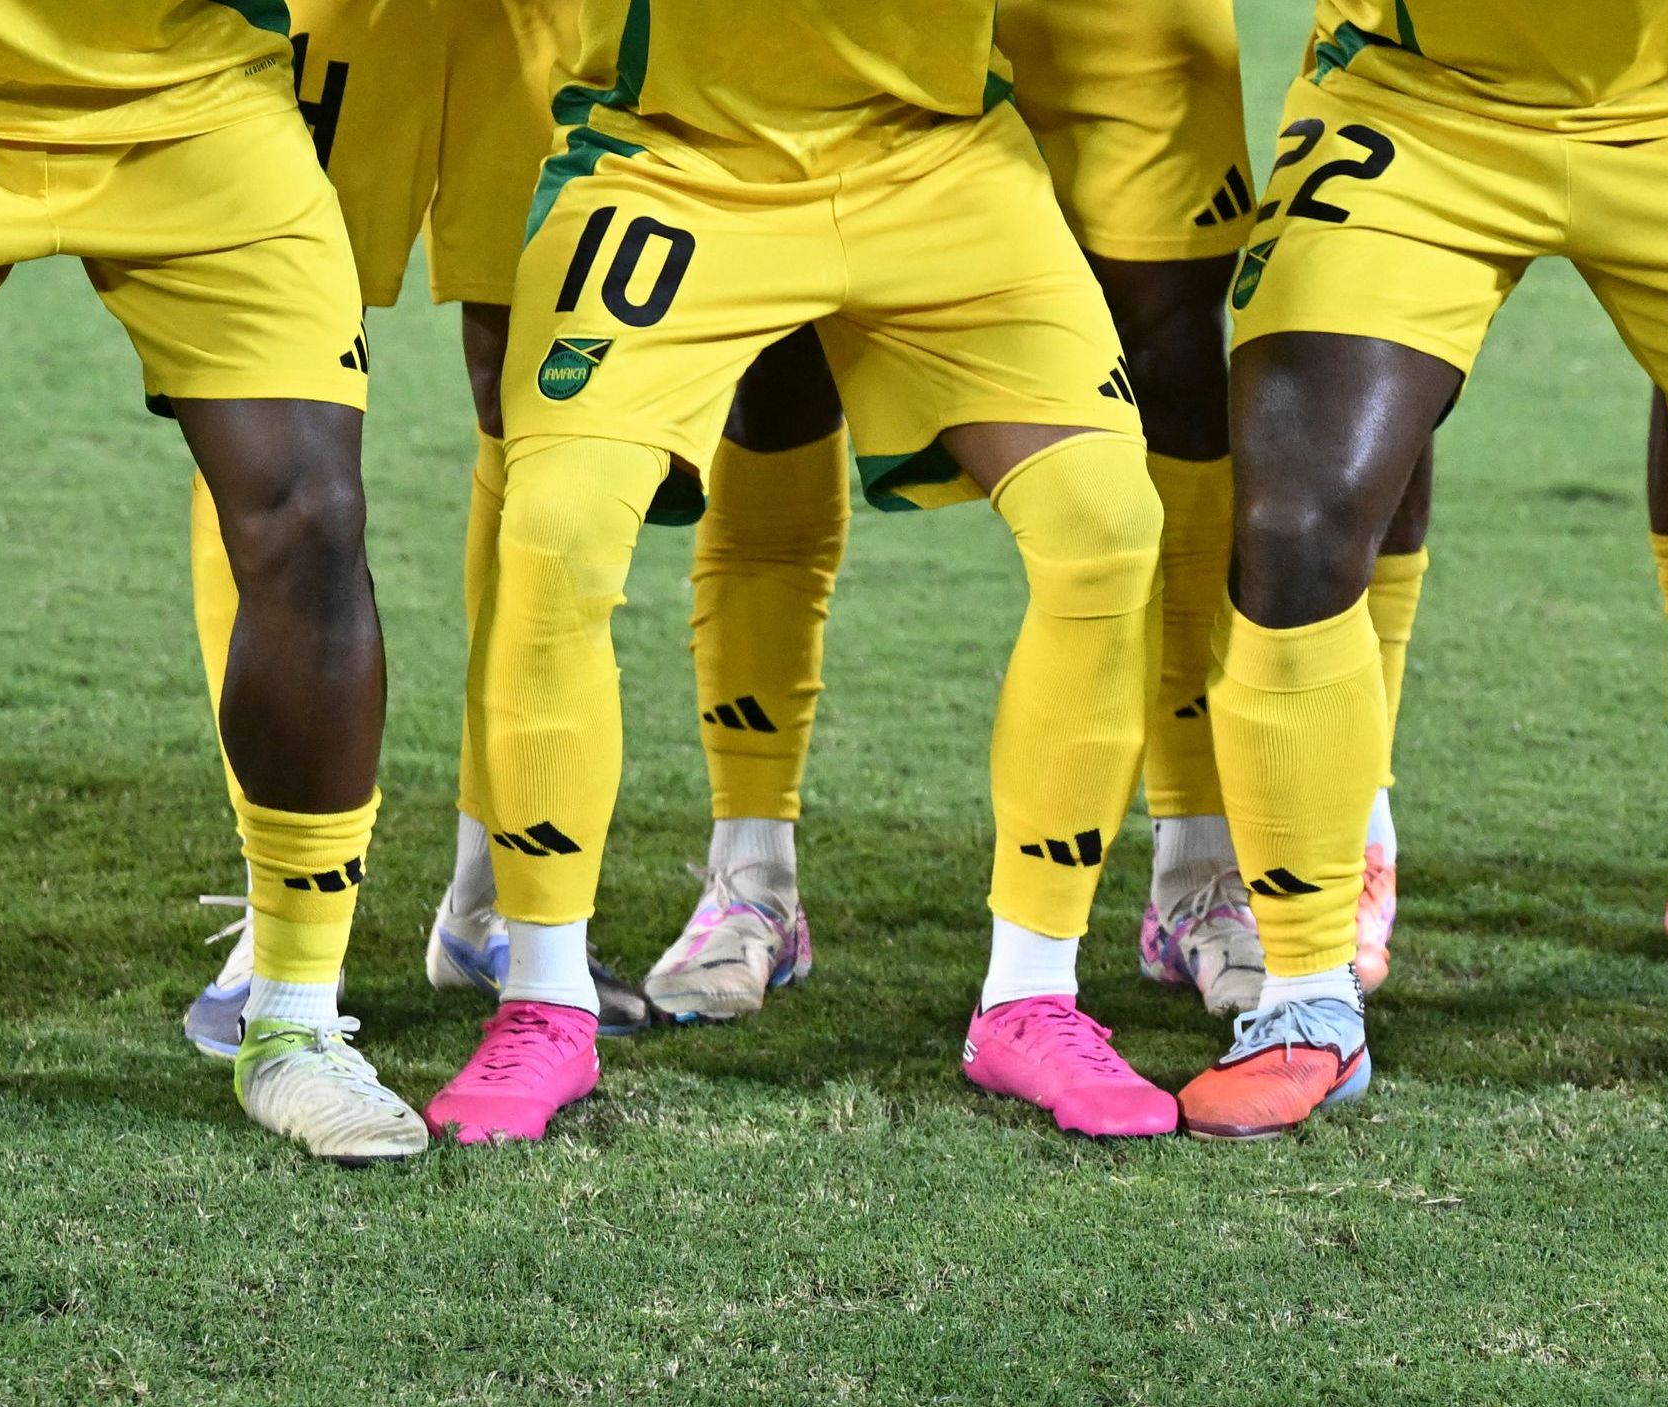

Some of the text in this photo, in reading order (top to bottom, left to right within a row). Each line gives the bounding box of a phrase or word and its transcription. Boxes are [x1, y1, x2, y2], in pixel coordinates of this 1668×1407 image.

[289, 32, 349, 173] 4
[1256, 119, 1396, 224] 22
[555, 206, 696, 327] 10
